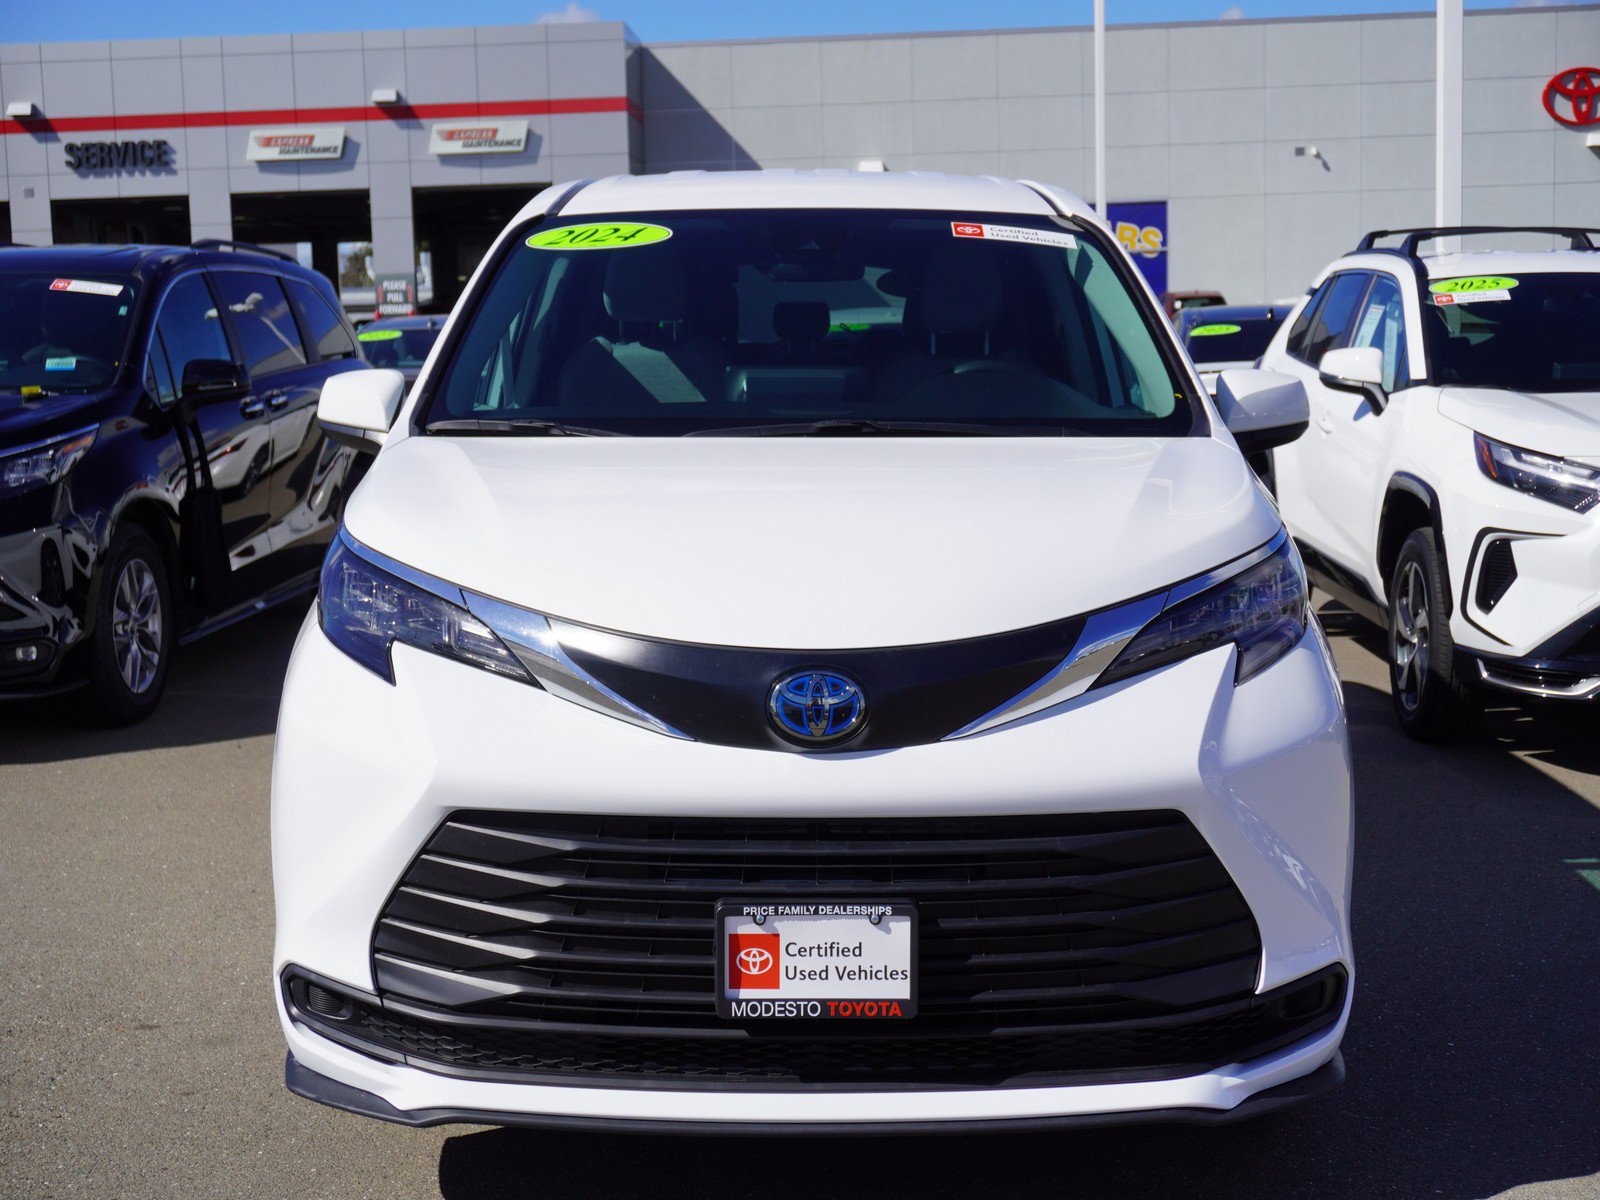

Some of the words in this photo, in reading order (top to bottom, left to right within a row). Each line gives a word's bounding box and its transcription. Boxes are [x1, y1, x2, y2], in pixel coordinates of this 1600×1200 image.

[64, 140, 172, 169] SERVICE
[543, 226, 648, 246] 2024
[990, 226, 1039, 236] Certified
[991, 232, 1019, 240] Used
[1023, 235, 1069, 246] Vehicles
[1106, 220, 1163, 258] RS
[383, 280, 407, 290] PLEASE
[1445, 279, 1502, 292] 2025
[387, 291, 404, 302] PULL
[743, 906, 775, 916] PRICE
[778, 905, 816, 916] FAMILY
[818, 905, 893, 916] DEALERSHIPS
[785, 941, 863, 958] Certified
[785, 965, 829, 981] Used
[835, 965, 909, 981] Vehicles
[731, 1001, 821, 1018] MODESTO
[827, 1001, 903, 1018] TOYOTA
